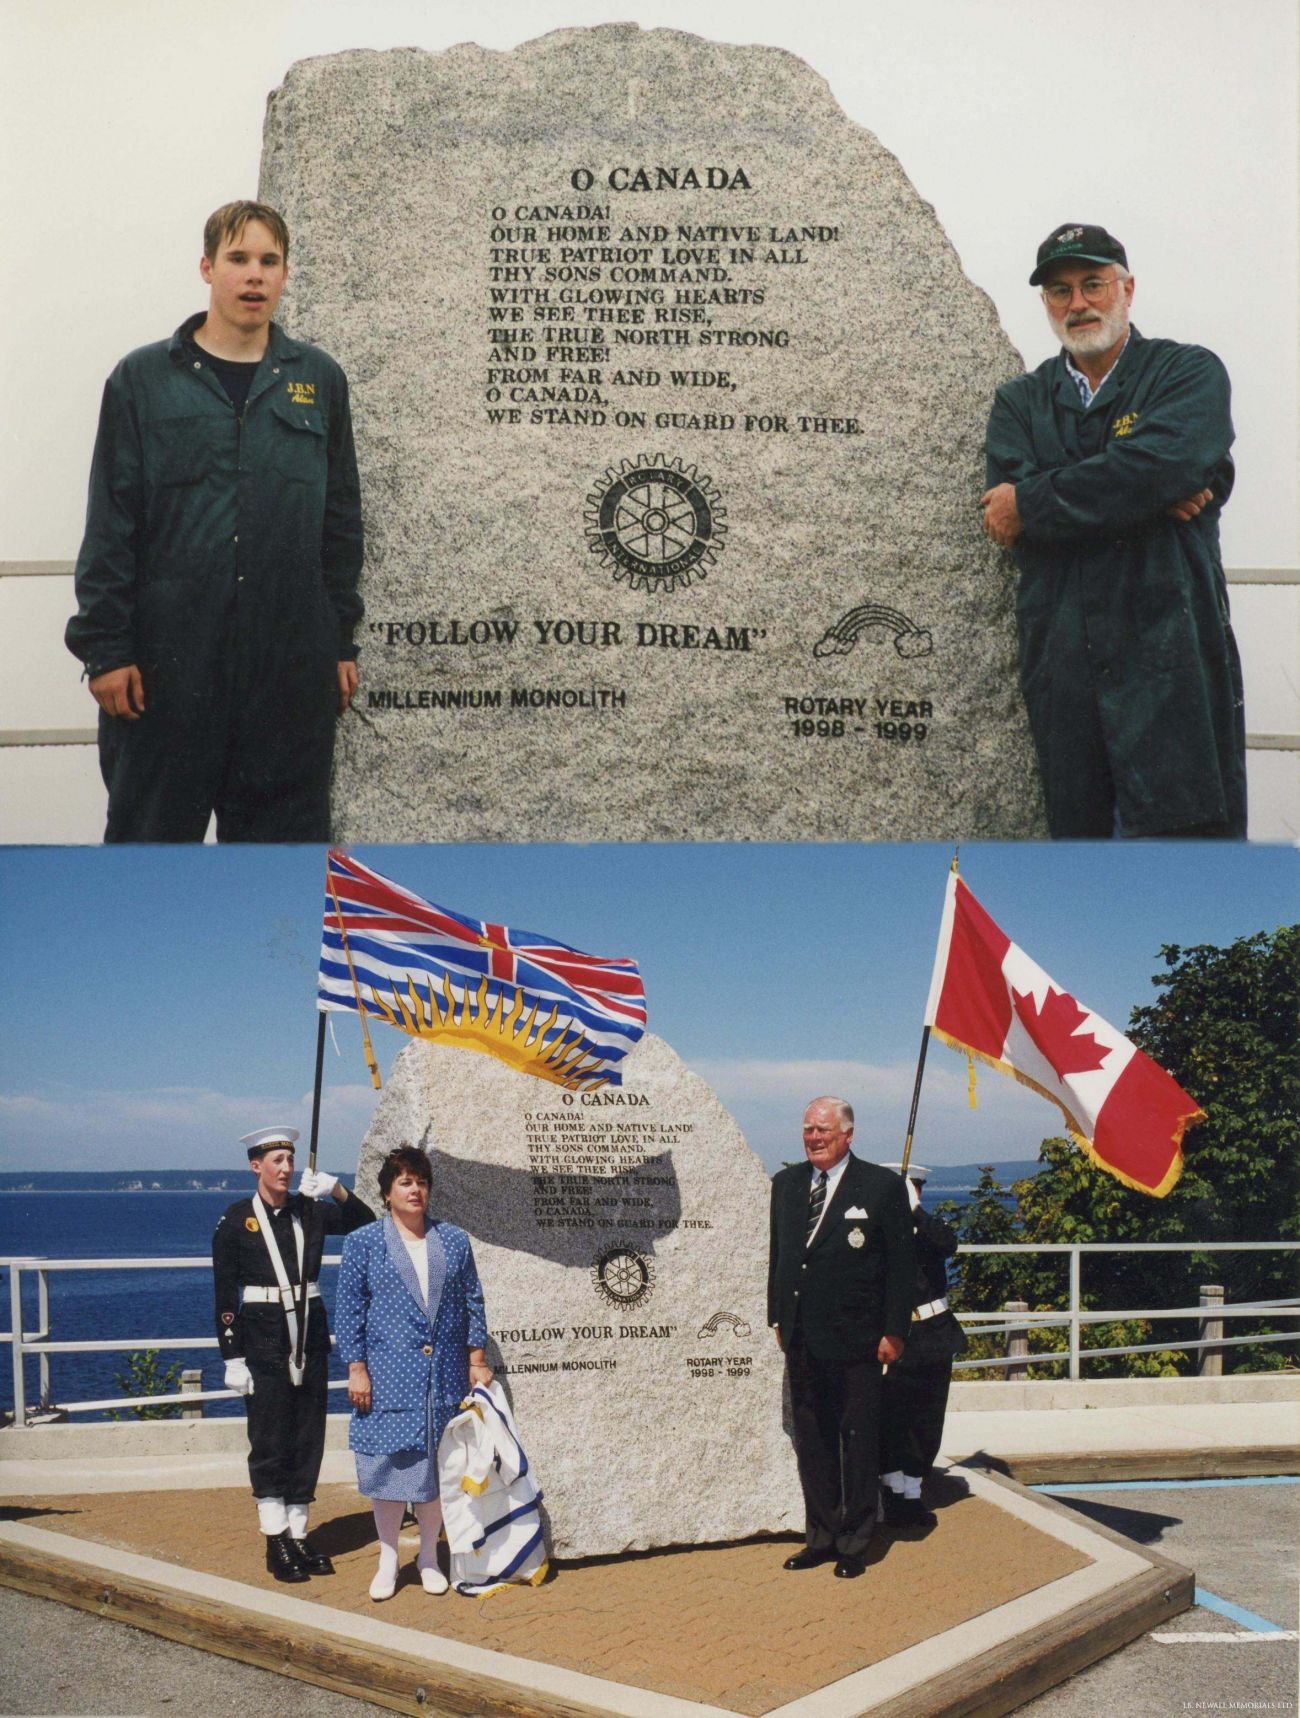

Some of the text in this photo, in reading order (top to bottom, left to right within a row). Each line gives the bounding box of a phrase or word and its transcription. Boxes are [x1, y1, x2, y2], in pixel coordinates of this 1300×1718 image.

[571, 167, 752, 191] O CANADA
[492, 206, 610, 221] O CANADA!
[490, 226, 838, 242] OUR HOME AND NATIVE LAND!
[490, 249, 808, 264] TRUE PATRIOT LOVE IN ALL
[490, 267, 732, 283] THY SONS COMMAND.
[490, 289, 765, 305] WITH GLOWING HEARTS
[490, 307, 712, 327] WE SEE THEE RISE,
[488, 328, 790, 347] THE TRUE NORTH STRONG
[488, 347, 610, 362] AND FREE!
[487, 369, 737, 392] FROM FAR AND WIDE,
[486, 388, 608, 405] O CANADA,
[487, 410, 864, 434] WE STAND ON GUARD FOR THEE.
[629, 472, 686, 489] ROTARY
[607, 539, 704, 574] INTERNATIONAL
[534, 622, 622, 645] YOUR
[368, 690, 626, 709] MILLENNIUM MONOLITH
[785, 698, 933, 719] ROTARY YEAR
[791, 721, 844, 738] 1998
[876, 722, 927, 741] 1999
[563, 1094, 650, 1106] O CANADA
[526, 1124, 692, 1133] OUR HOME AND NATIVE LAND!
[527, 1135, 680, 1143] TRUE PATRIOT LOVE IN ALL
[564, 1156, 615, 1164] GLOWING
[620, 1156, 663, 1164] HEARTS
[553, 1165, 573, 1173] SEE
[577, 1165, 606, 1173] THEE
[612, 1165, 639, 1174] RISE,
[532, 1177, 676, 1186] THE TRUE NORTH STRONG
[561, 1187, 592, 1195] FREE!
[534, 1198, 563, 1206] FROM
[569, 1198, 589, 1206] FAR
[594, 1198, 617, 1207] AND
[558, 1220, 593, 1228] STAND
[598, 1220, 613, 1228] ON
[617, 1220, 655, 1228] GUARD
[659, 1220, 679, 1228] FOR
[683, 1221, 713, 1229] THEE.
[572, 1327, 613, 1339] YOUR
[494, 1360, 616, 1374] MILLENNIUM MONOLITH
[687, 1357, 752, 1367] ROTARY YEAR
[691, 1369, 714, 1377] 1998
[727, 1367, 750, 1376] 1999
